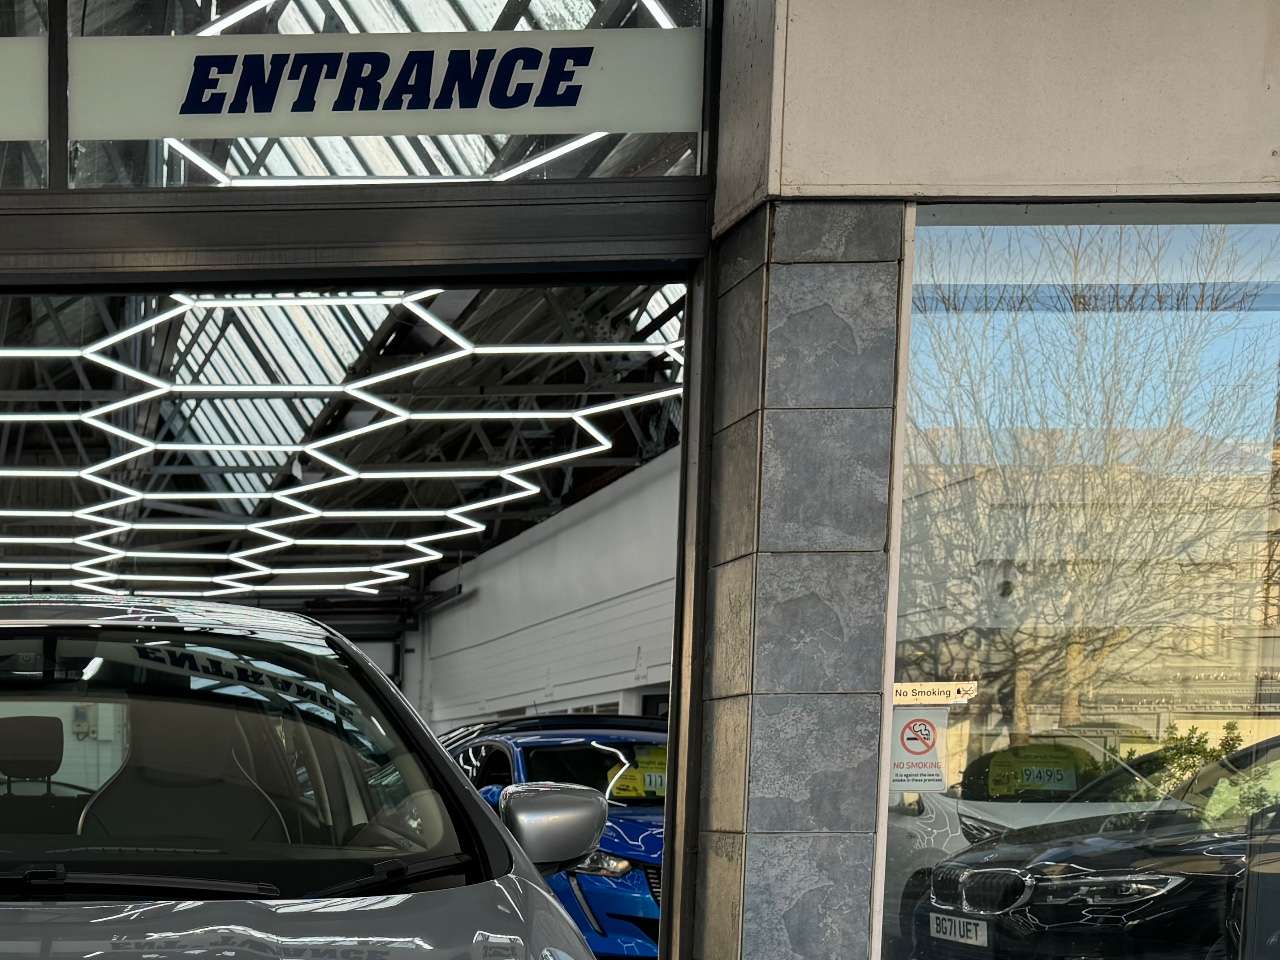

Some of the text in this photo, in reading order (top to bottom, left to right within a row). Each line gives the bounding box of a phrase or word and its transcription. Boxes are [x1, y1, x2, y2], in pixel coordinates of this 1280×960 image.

[178, 46, 594, 115] ENTRANCE
[895, 688, 951, 698] No Smoking
[893, 761, 943, 769] NO SMOKING
[935, 916, 980, 942] BG71 UET
